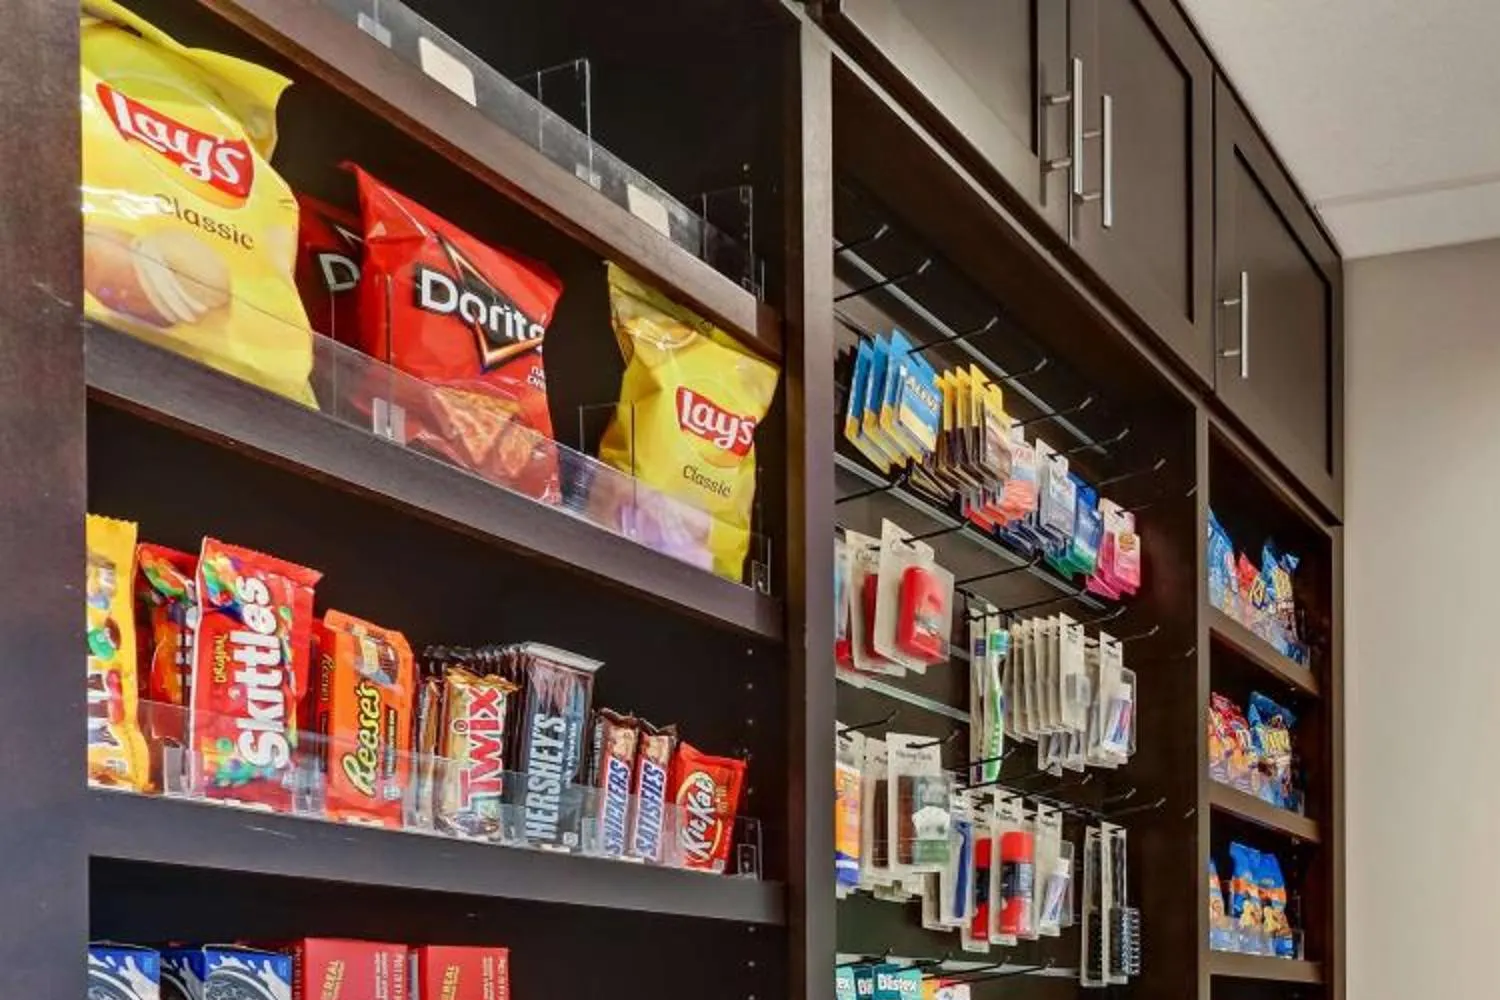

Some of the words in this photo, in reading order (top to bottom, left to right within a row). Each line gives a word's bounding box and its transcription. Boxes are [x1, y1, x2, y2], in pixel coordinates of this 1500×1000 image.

[109, 92, 246, 185] Lay's
[153, 193, 255, 250] Classic
[420, 267, 546, 345] Dorito
[679, 390, 757, 448] Lay's
[683, 463, 732, 498] Classic
[228, 576, 290, 770] Skittles
[342, 681, 381, 796] Reese's
[525, 713, 566, 840] HERSHEY'S
